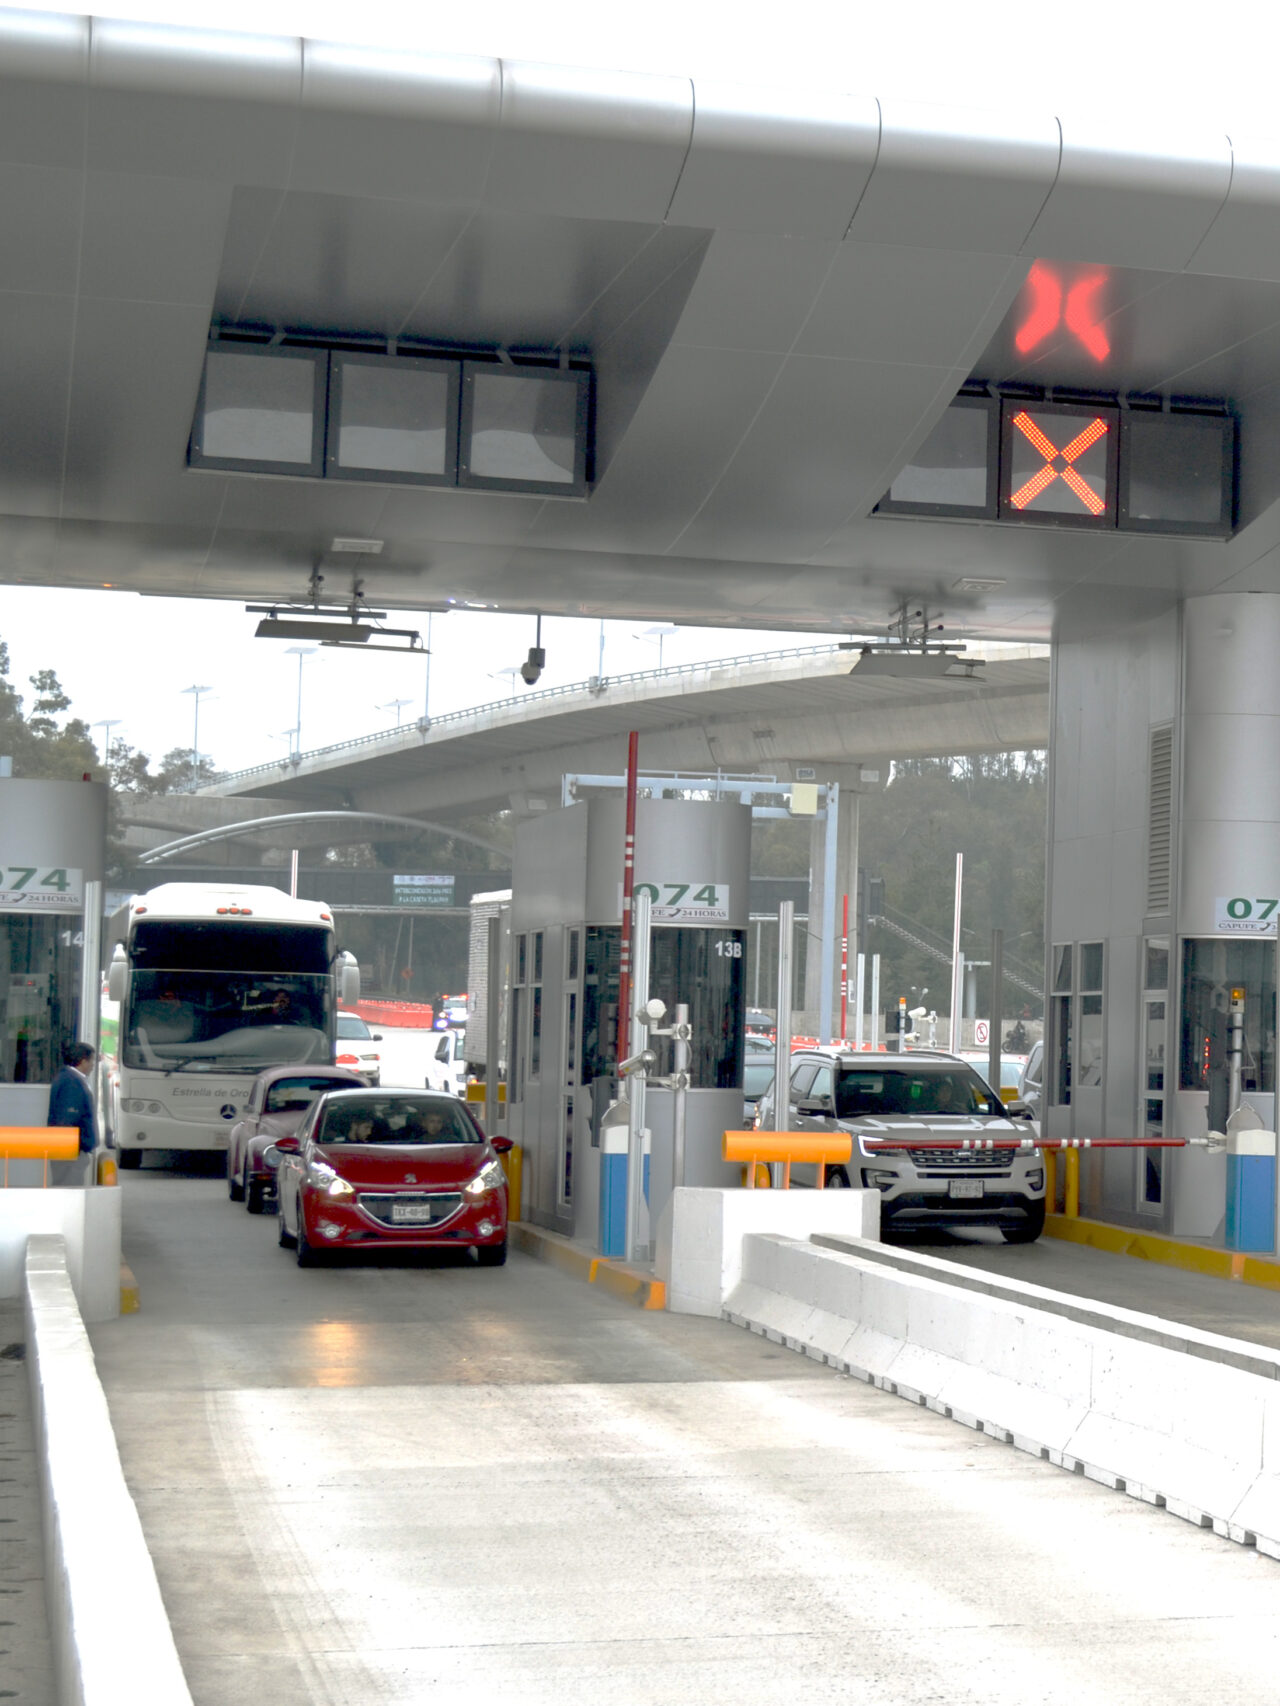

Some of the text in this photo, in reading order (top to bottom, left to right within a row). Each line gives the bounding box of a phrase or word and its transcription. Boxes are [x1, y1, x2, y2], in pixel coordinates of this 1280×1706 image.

[0, 867, 71, 892] 74
[42, 895, 80, 903] HORAS
[633, 883, 719, 907] 074
[694, 909, 727, 918] HORAS
[1218, 922, 1257, 930] CAPUFE
[715, 941, 742, 958] 13B
[172, 1087, 249, 1098] Estrella de Oro
